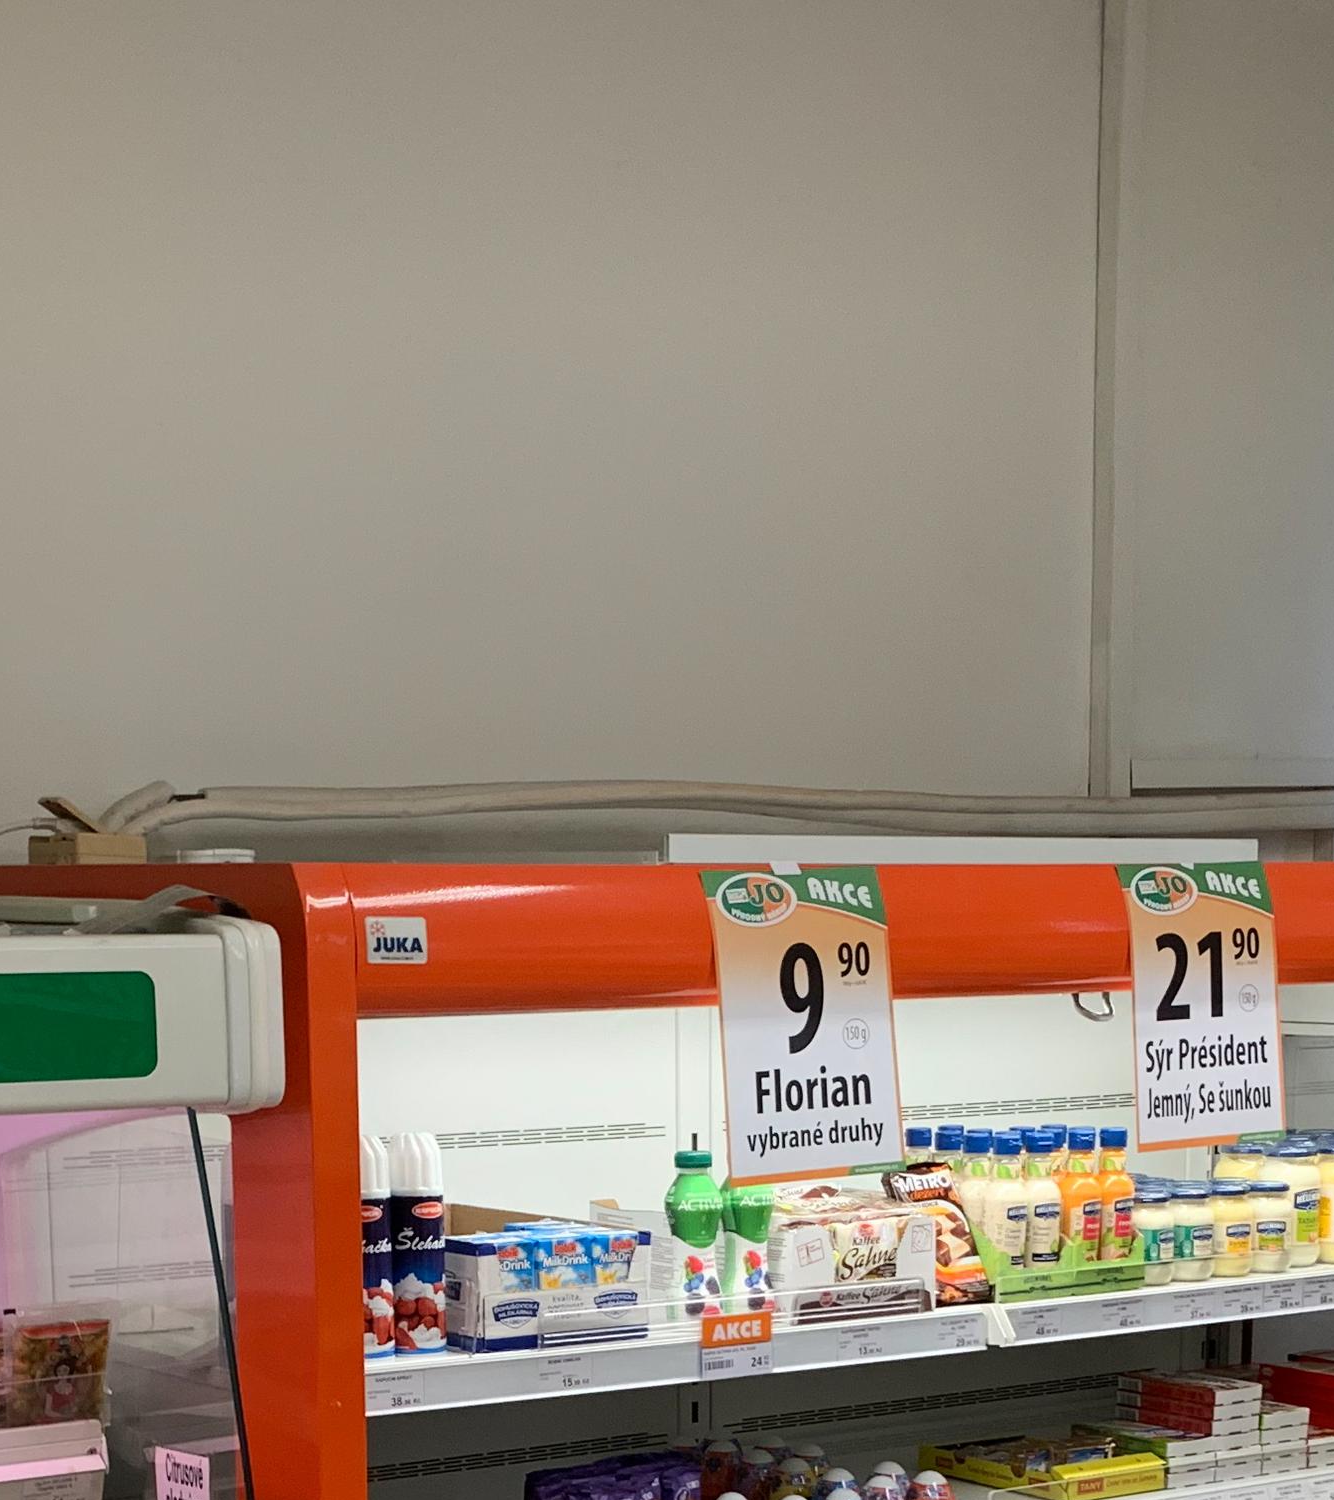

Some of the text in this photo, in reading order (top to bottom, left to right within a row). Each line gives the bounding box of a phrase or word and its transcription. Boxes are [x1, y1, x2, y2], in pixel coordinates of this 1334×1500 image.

[807, 877, 873, 909] AKCE
[1205, 870, 1262, 899] AKCE
[373, 936, 423, 953] JUKA
[1155, 927, 1260, 1021] 21 90
[779, 941, 870, 1054] 9 90
[845, 1024, 858, 1041] 150
[1146, 1034, 1268, 1080] Sýr Président
[755, 1065, 872, 1115] Florian
[1147, 1079, 1271, 1124] Jemný, Se šunkou
[747, 1117, 884, 1157] vybrané druhy
[895, 1173, 951, 1193] METRO
[542, 1254, 589, 1268] MilkDrink
[839, 1248, 898, 1281] Sahne
[712, 1319, 762, 1343] AKCE
[751, 1357, 763, 1368] 24
[166, 1454, 204, 1489] Citrusové
